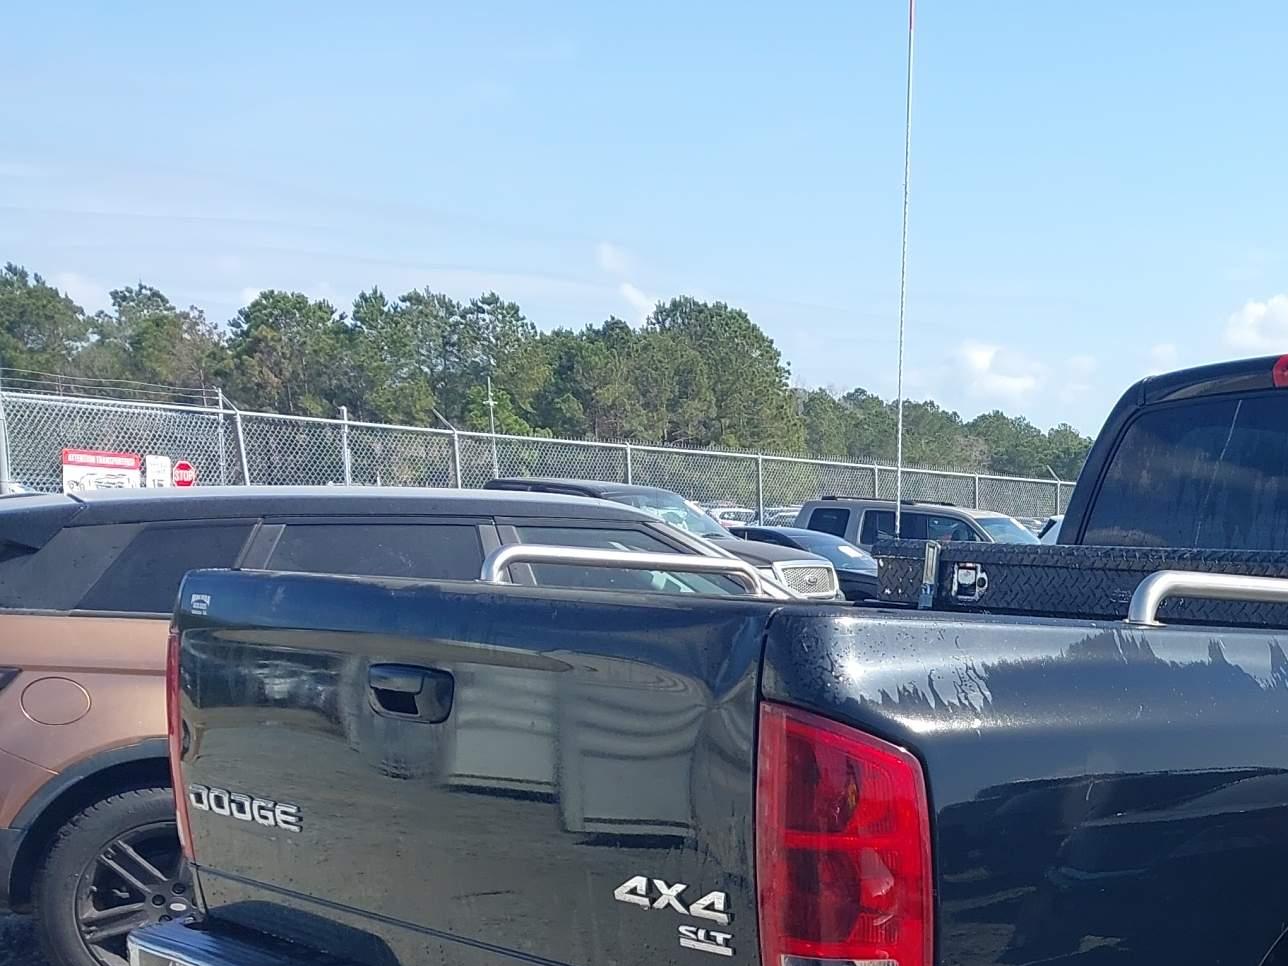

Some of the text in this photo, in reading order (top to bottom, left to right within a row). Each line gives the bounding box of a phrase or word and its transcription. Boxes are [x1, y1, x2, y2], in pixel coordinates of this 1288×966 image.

[174, 469, 195, 482] STOP
[189, 783, 303, 832] DODGE
[614, 875, 730, 924] 4X4
[678, 925, 732, 947] SLT
